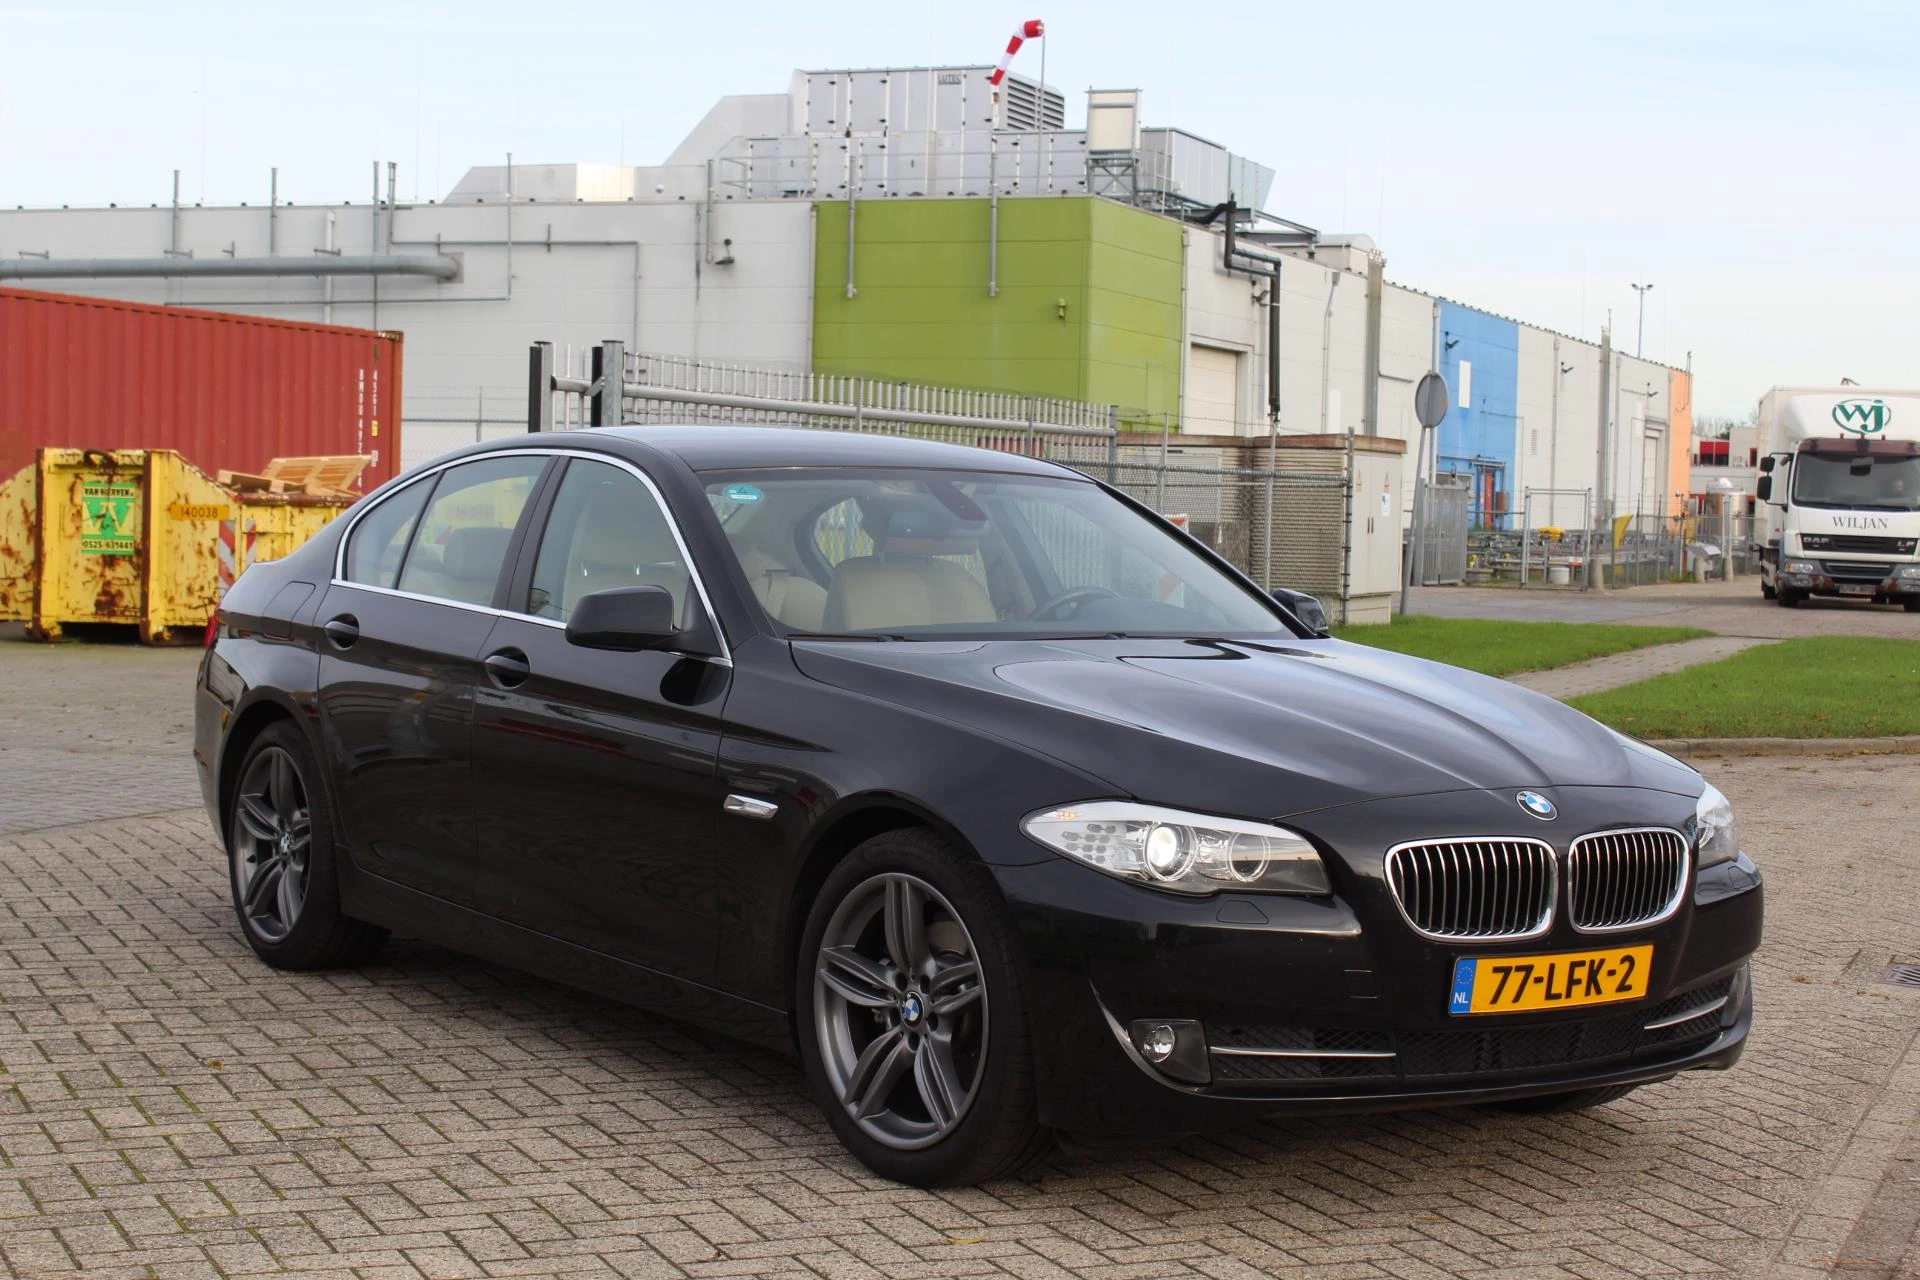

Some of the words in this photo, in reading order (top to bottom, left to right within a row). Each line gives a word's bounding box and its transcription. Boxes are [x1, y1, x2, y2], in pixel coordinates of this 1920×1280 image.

[181, 508, 218, 518] 140038
[1833, 516, 1889, 529] WILJAN
[1489, 954, 1636, 1005] 77-LFK-2
[1453, 992, 1469, 1004] NL
